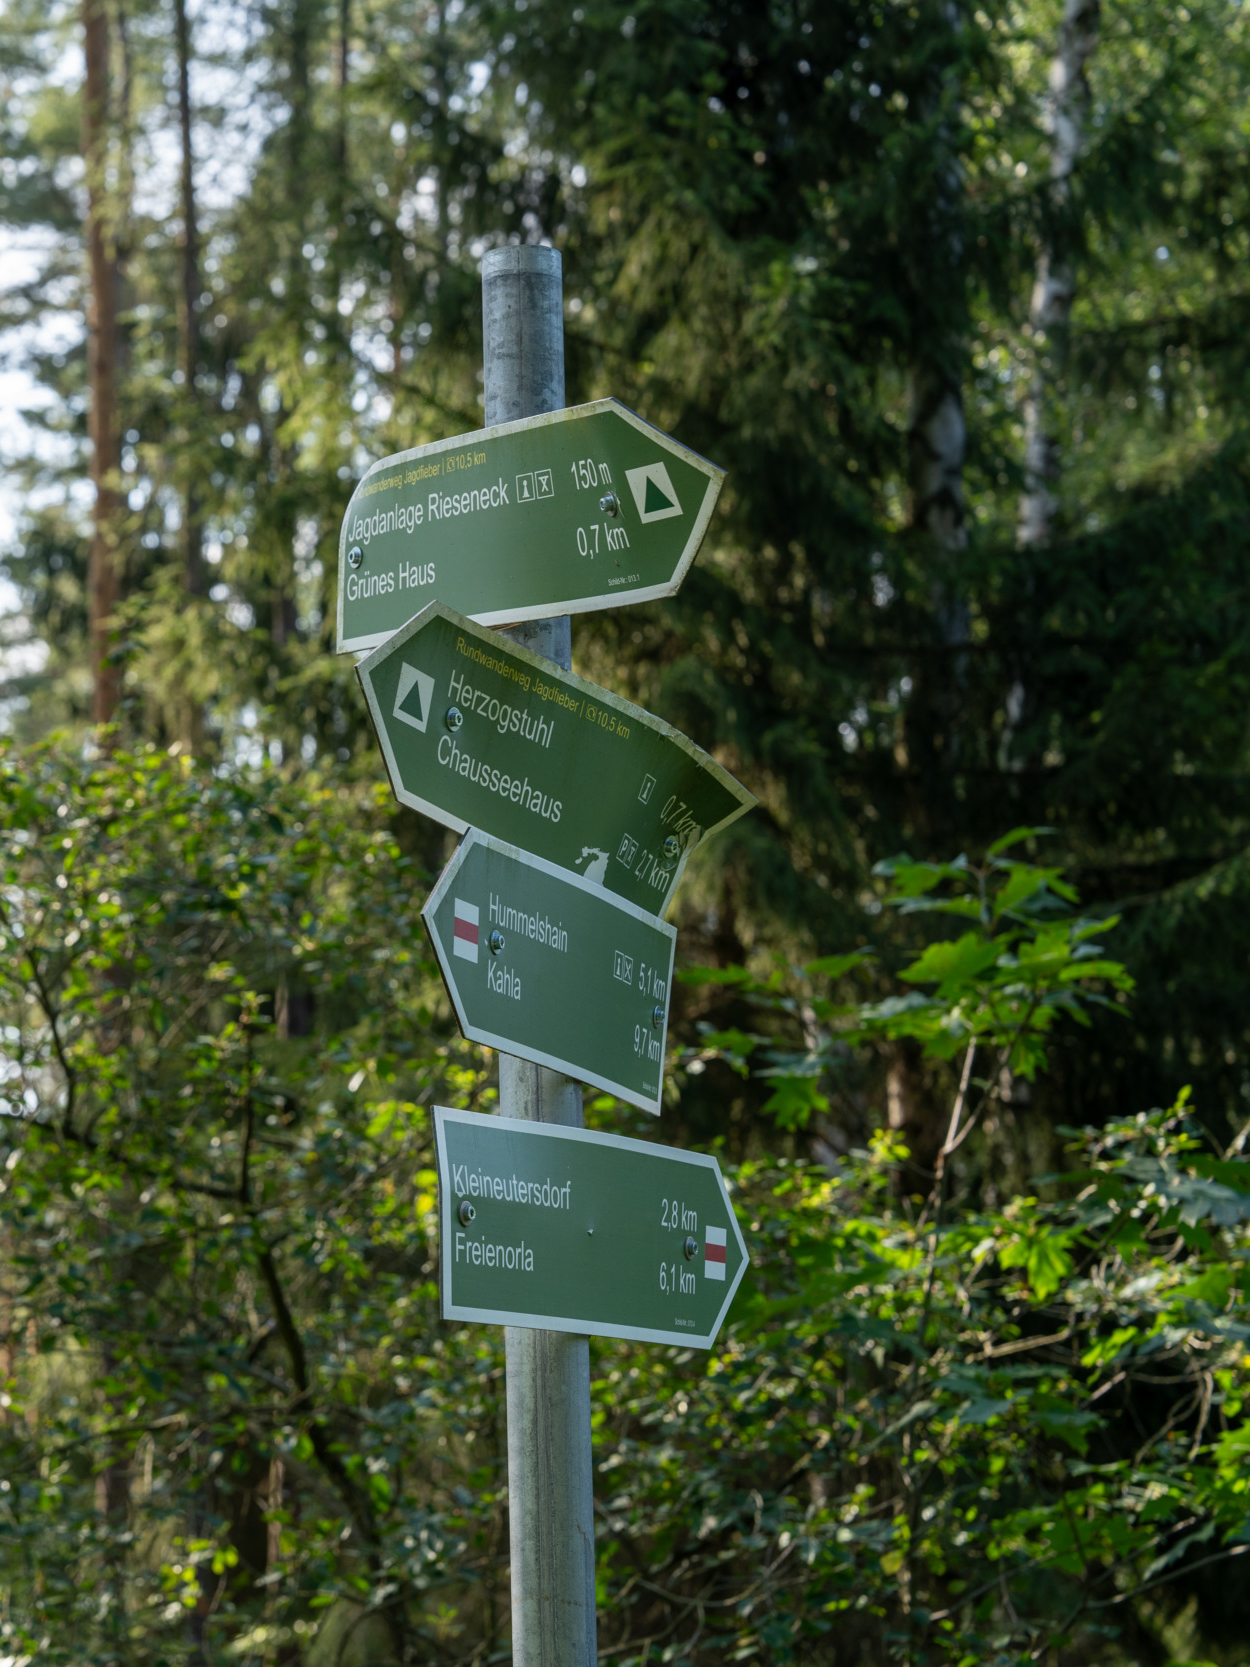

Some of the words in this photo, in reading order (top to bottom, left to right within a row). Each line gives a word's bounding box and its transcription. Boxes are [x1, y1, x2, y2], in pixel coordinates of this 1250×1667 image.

[348, 502, 424, 545] Jagdanlage
[428, 477, 510, 522] Rieseneck
[571, 458, 598, 490] 150
[599, 461, 613, 485] m
[403, 462, 441, 486] Jagdfieber
[455, 452, 472, 471] 10,5
[473, 451, 487, 468] km
[346, 571, 395, 601] Grünes
[399, 561, 436, 590] Haus
[576, 524, 600, 560] 0,7
[604, 522, 630, 551] km
[447, 669, 555, 748] Herzogstuhl
[456, 636, 531, 692] Rundwanderweg
[531, 676, 581, 713] Jagdfieber
[597, 710, 617, 732] 10,5
[616, 720, 630, 740] km
[437, 735, 563, 823] Chausseehaus
[635, 849, 654, 882] 2,7
[648, 858, 670, 893] km
[660, 795, 688, 825] 0,7
[673, 810, 701, 835] km
[488, 892, 568, 953] Hummelshain
[639, 962, 652, 997] 5,1
[653, 970, 665, 1002] km
[487, 959, 522, 1001] Kahla
[633, 1024, 648, 1058] 9,7
[647, 1030, 660, 1063] km
[452, 1163, 571, 1210] Kleineutersdorf
[661, 1198, 679, 1232] 2,8
[681, 1201, 698, 1232] km
[455, 1232, 534, 1272] Freienorla
[659, 1261, 676, 1296] 6,1
[679, 1264, 696, 1295] km
